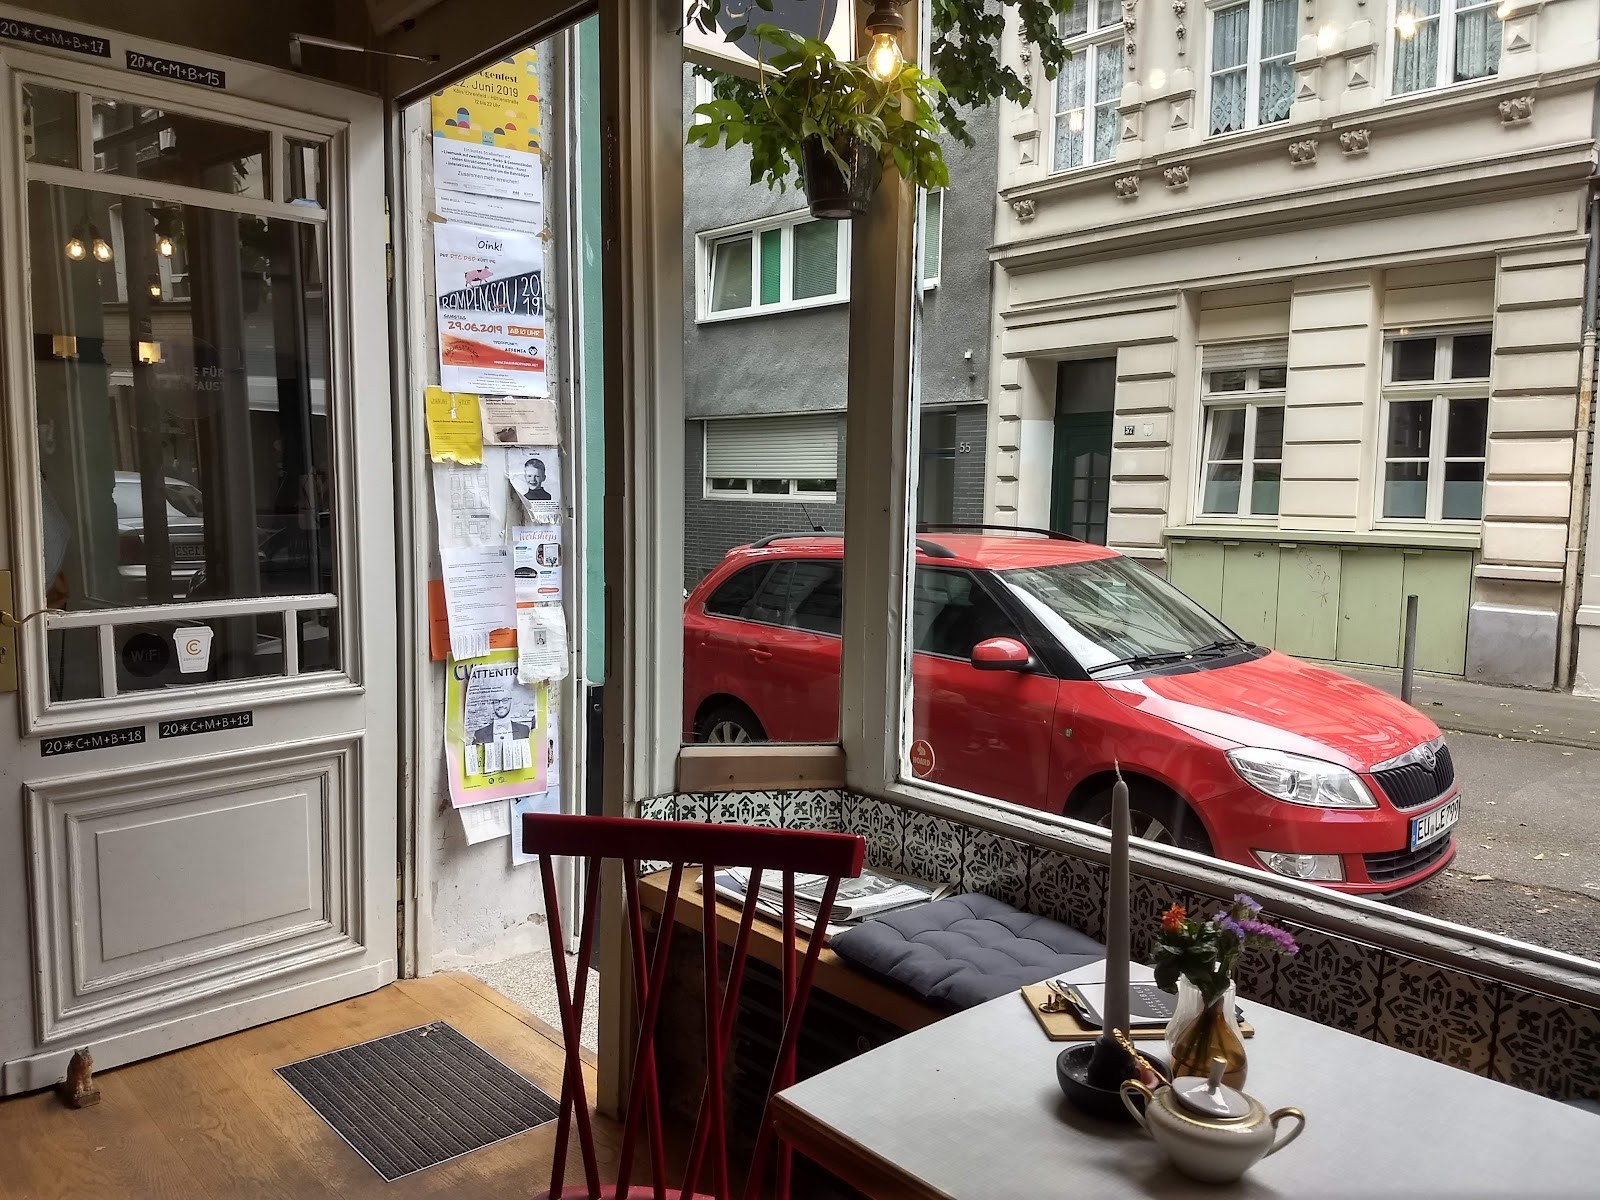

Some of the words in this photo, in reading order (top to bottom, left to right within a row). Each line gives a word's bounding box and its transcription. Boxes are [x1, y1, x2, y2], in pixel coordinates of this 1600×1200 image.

[472, 80, 494, 93] Juni
[497, 84, 519, 98] 2019
[477, 240, 503, 252] Oink!
[521, 275, 541, 297] 20
[442, 279, 518, 314] RAMPENSAU
[523, 297, 541, 317] 19
[447, 320, 503, 335] 29.06.2019
[527, 329, 541, 338] UHR
[959, 442, 971, 453] 55
